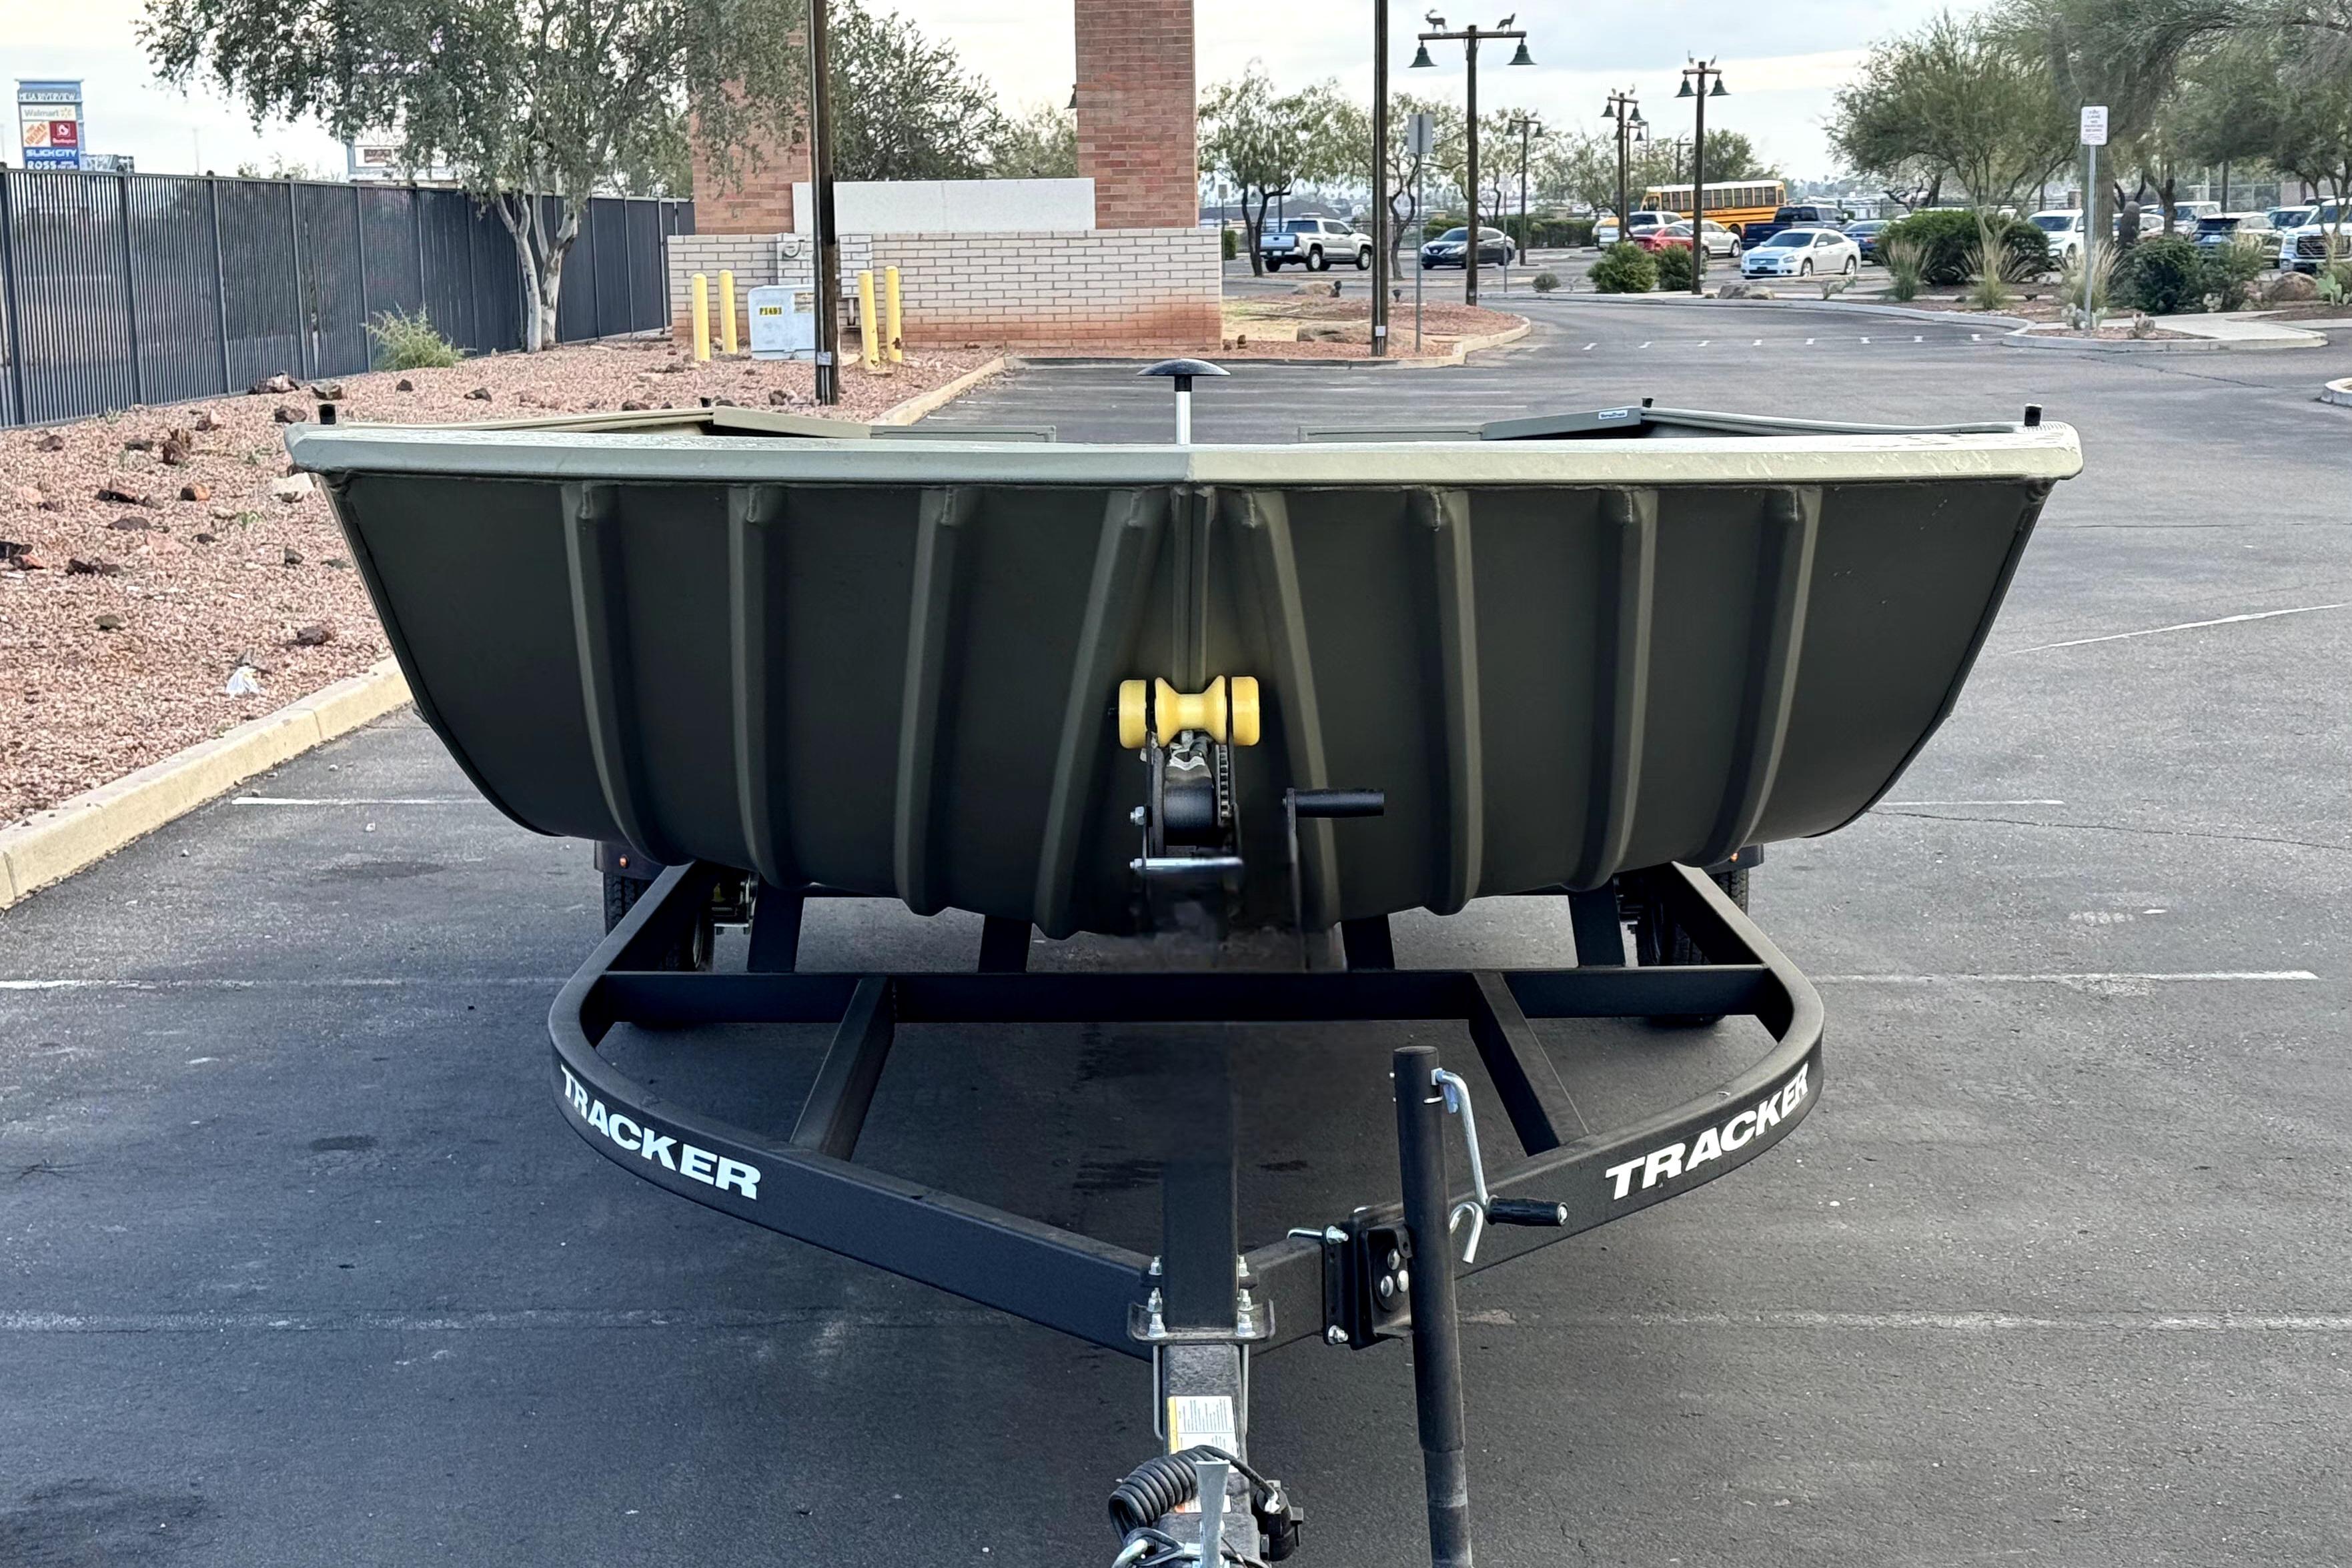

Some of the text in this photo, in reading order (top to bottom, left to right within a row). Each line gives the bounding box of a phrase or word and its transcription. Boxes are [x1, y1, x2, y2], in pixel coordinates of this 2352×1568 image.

[24, 109, 59, 117] Walmart
[55, 149, 77, 157] CITY
[27, 161, 57, 169] ROSS
[560, 1064, 761, 1200] TRACKER
[1605, 1062, 1808, 1200] TRACKER
